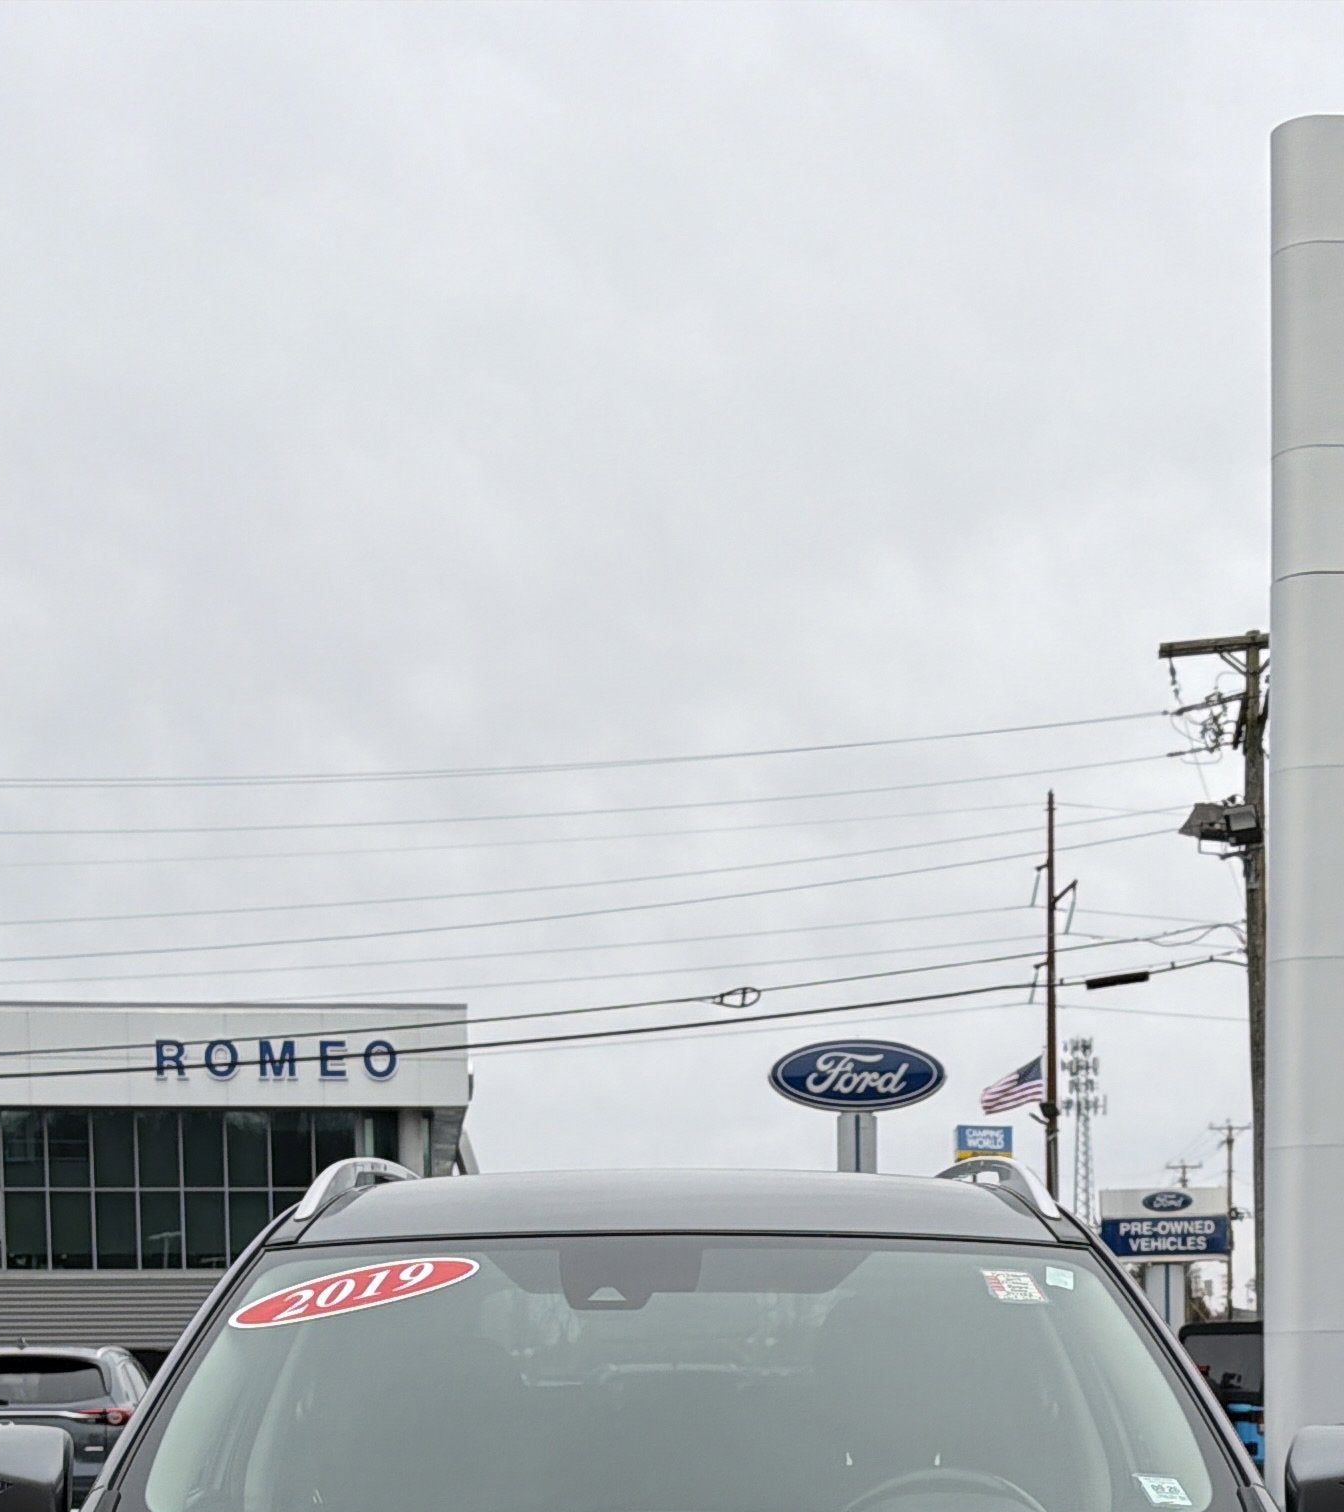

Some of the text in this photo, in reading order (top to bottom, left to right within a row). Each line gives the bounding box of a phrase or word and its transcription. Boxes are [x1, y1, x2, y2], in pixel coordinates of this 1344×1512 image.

[155, 1039, 397, 1079] ROMEO
[806, 1052, 909, 1094] Ford
[966, 1137, 1005, 1149] WORLD
[1152, 1194, 1184, 1208] Ford
[1119, 1220, 1215, 1236] PRE-OWNED
[1129, 1236, 1207, 1252] VEHICLES
[271, 1262, 434, 1321] 2019
